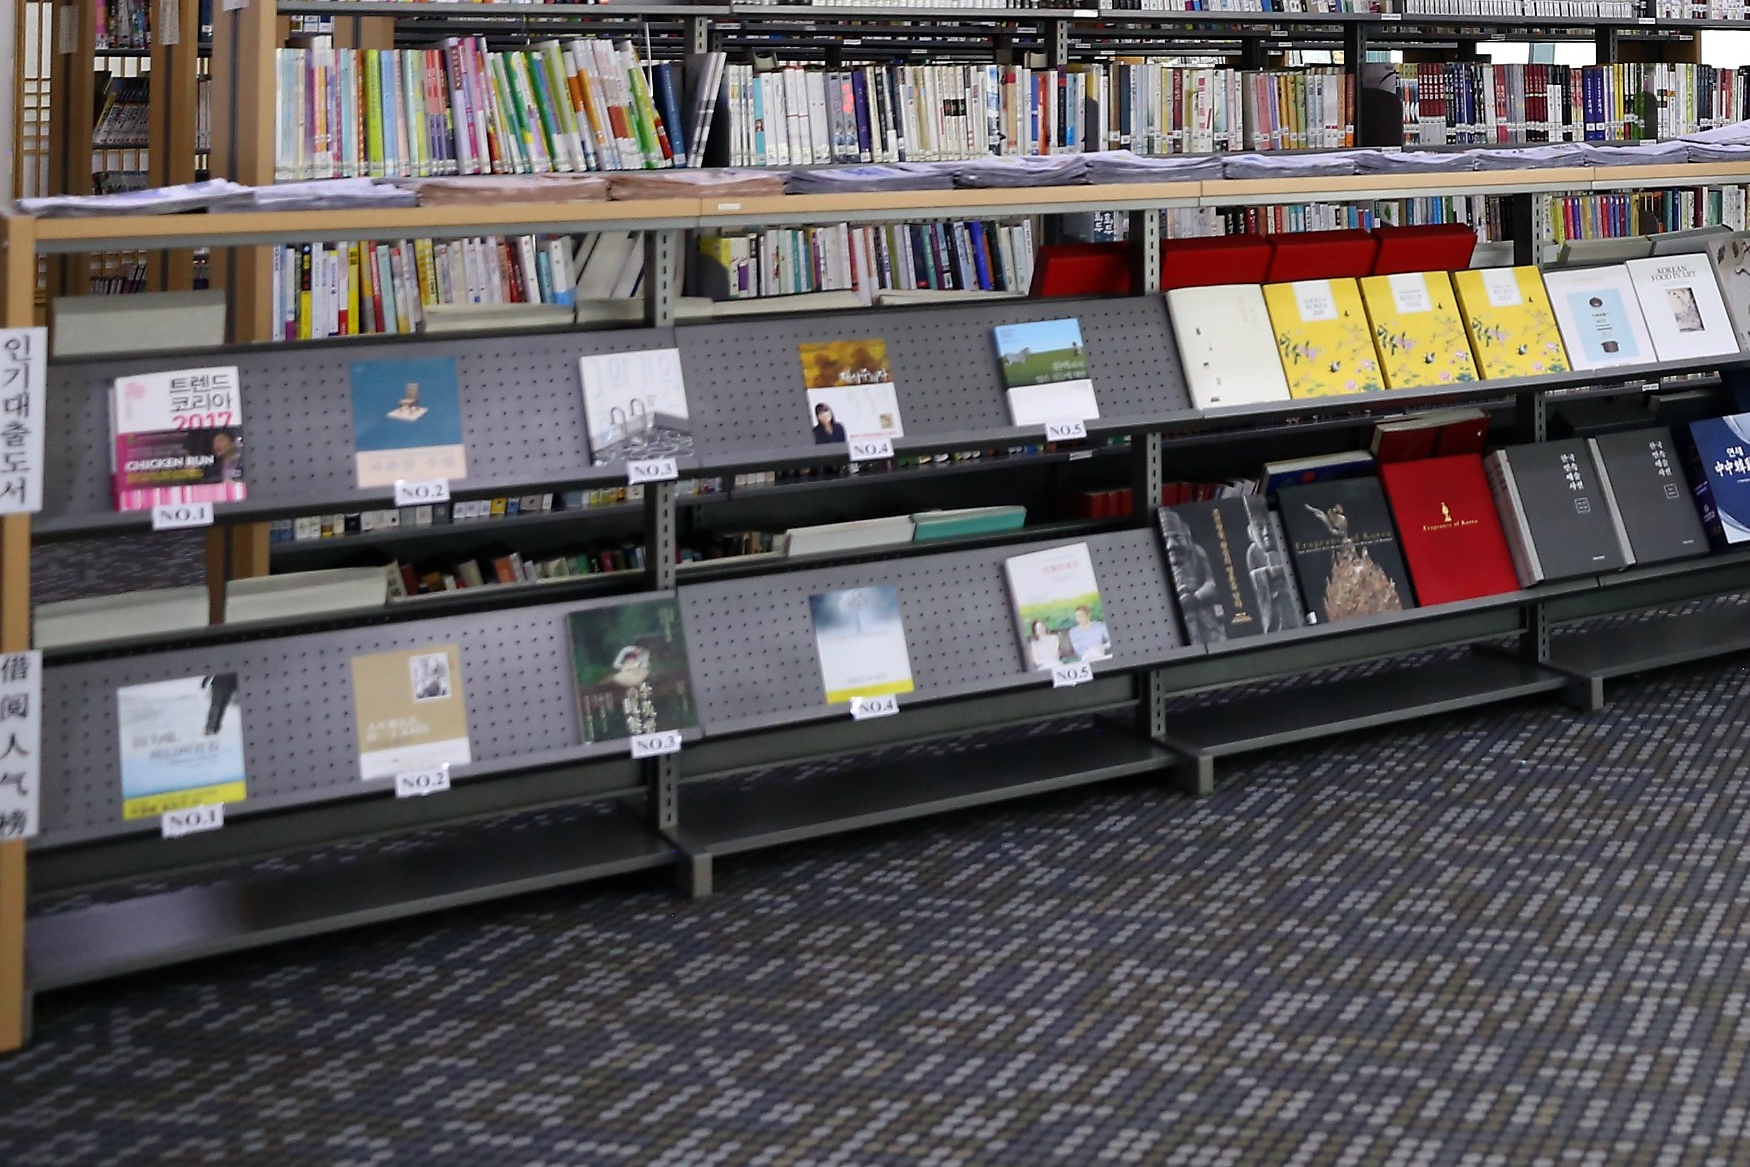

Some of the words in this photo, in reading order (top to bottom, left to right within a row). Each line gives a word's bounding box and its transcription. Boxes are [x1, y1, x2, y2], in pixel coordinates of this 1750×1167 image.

[1651, 272, 1671, 282] FOOD
[1682, 270, 1696, 279] ART
[1656, 264, 1687, 275] KOREAN
[170, 374, 231, 394] 트렌드
[171, 392, 232, 412] 코리아
[172, 411, 232, 431] 2017
[1049, 423, 1082, 435] NO.5
[854, 442, 888, 454] NO.4
[126, 457, 184, 471] CHICKEN
[185, 454, 214, 466] RUN
[635, 463, 672, 476] NO.3
[402, 484, 444, 498] NO.2
[160, 506, 206, 522] NO.1
[1057, 667, 1089, 680] NO.5
[860, 699, 894, 712] NO.4
[637, 735, 676, 749] NO.3
[403, 772, 445, 787] NO.2
[170, 809, 215, 826] NO.1
